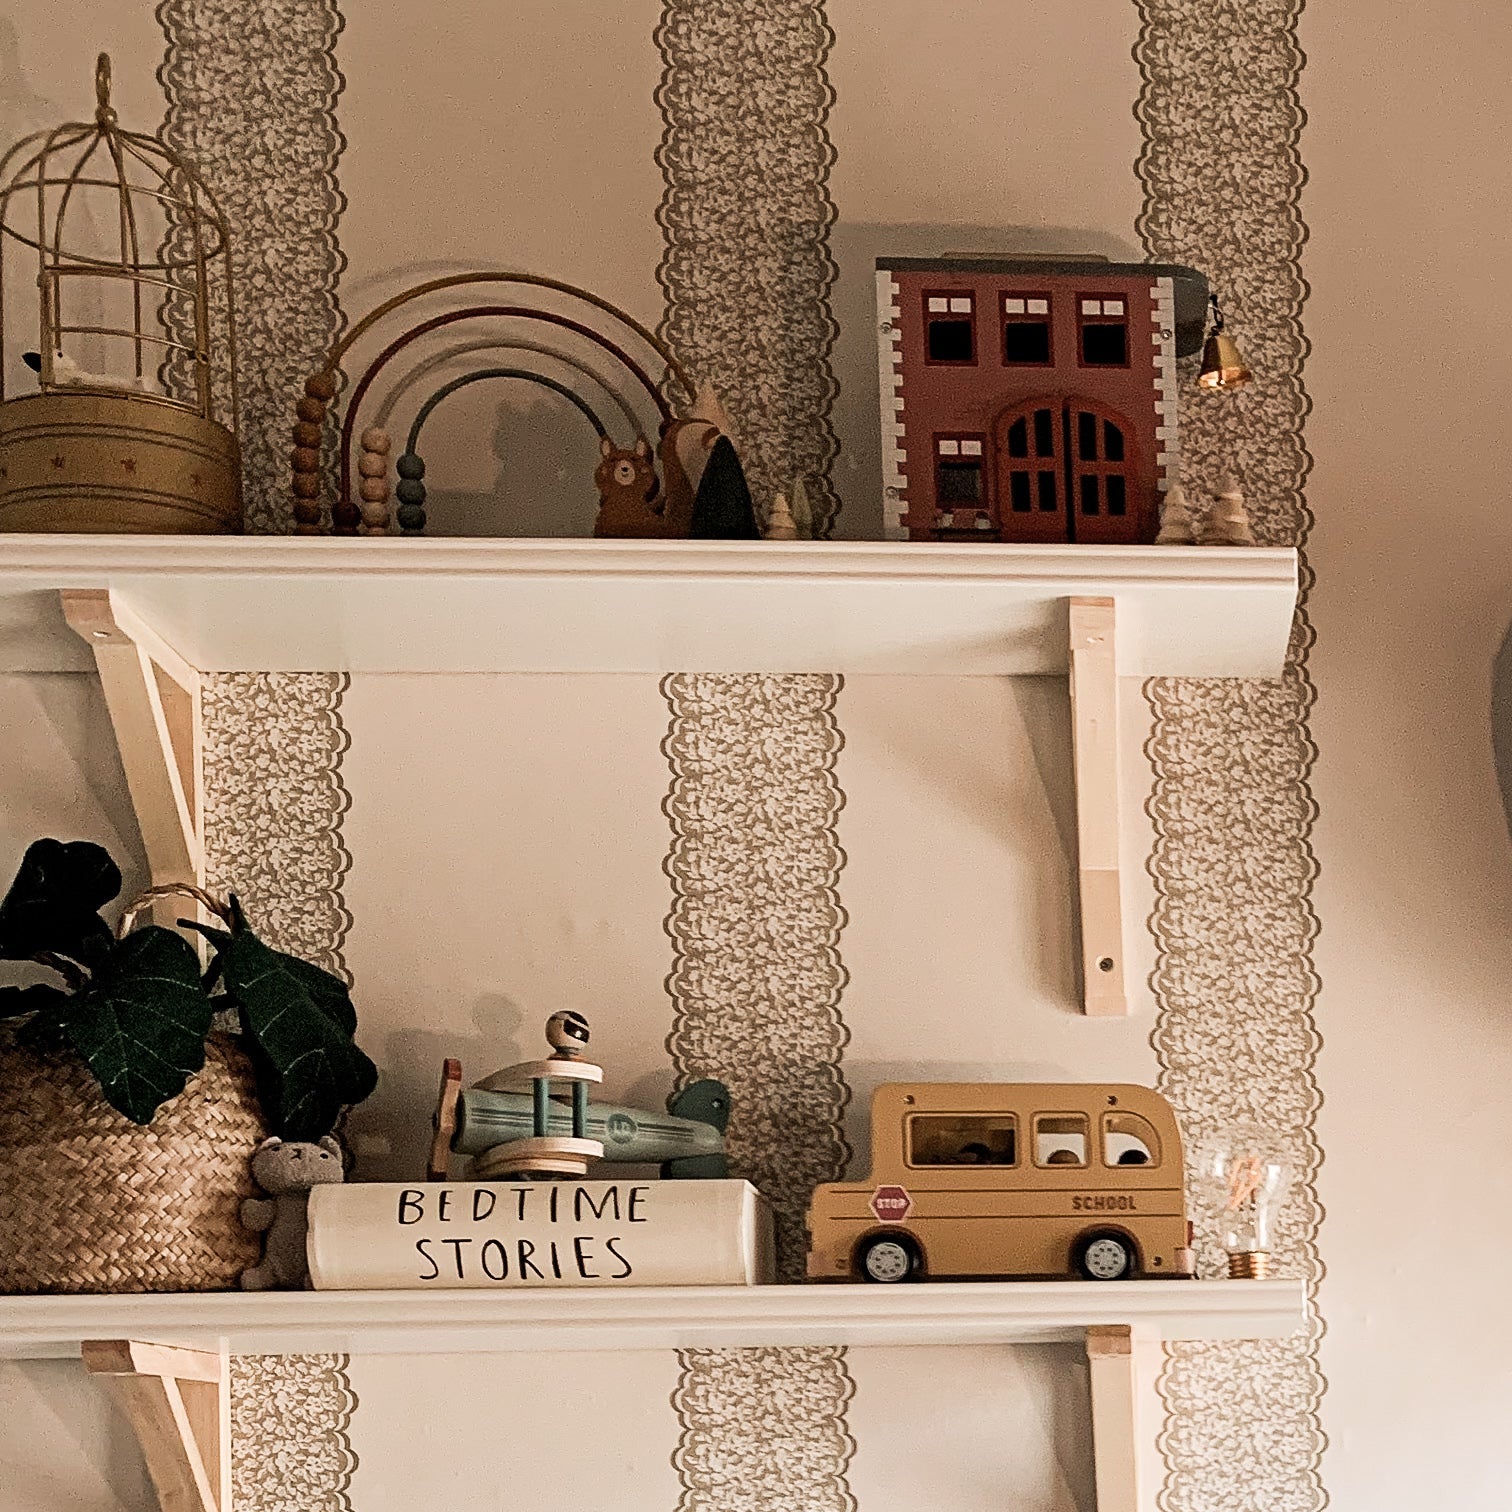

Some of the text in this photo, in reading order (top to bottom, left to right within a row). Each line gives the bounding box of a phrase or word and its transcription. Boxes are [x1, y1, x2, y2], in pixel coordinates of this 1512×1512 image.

[397, 1185, 650, 1225] BEDTIME
[876, 1198, 907, 1209] STOP
[1072, 1195, 1137, 1210] SCHOOL
[415, 1236, 632, 1281] STORIES
